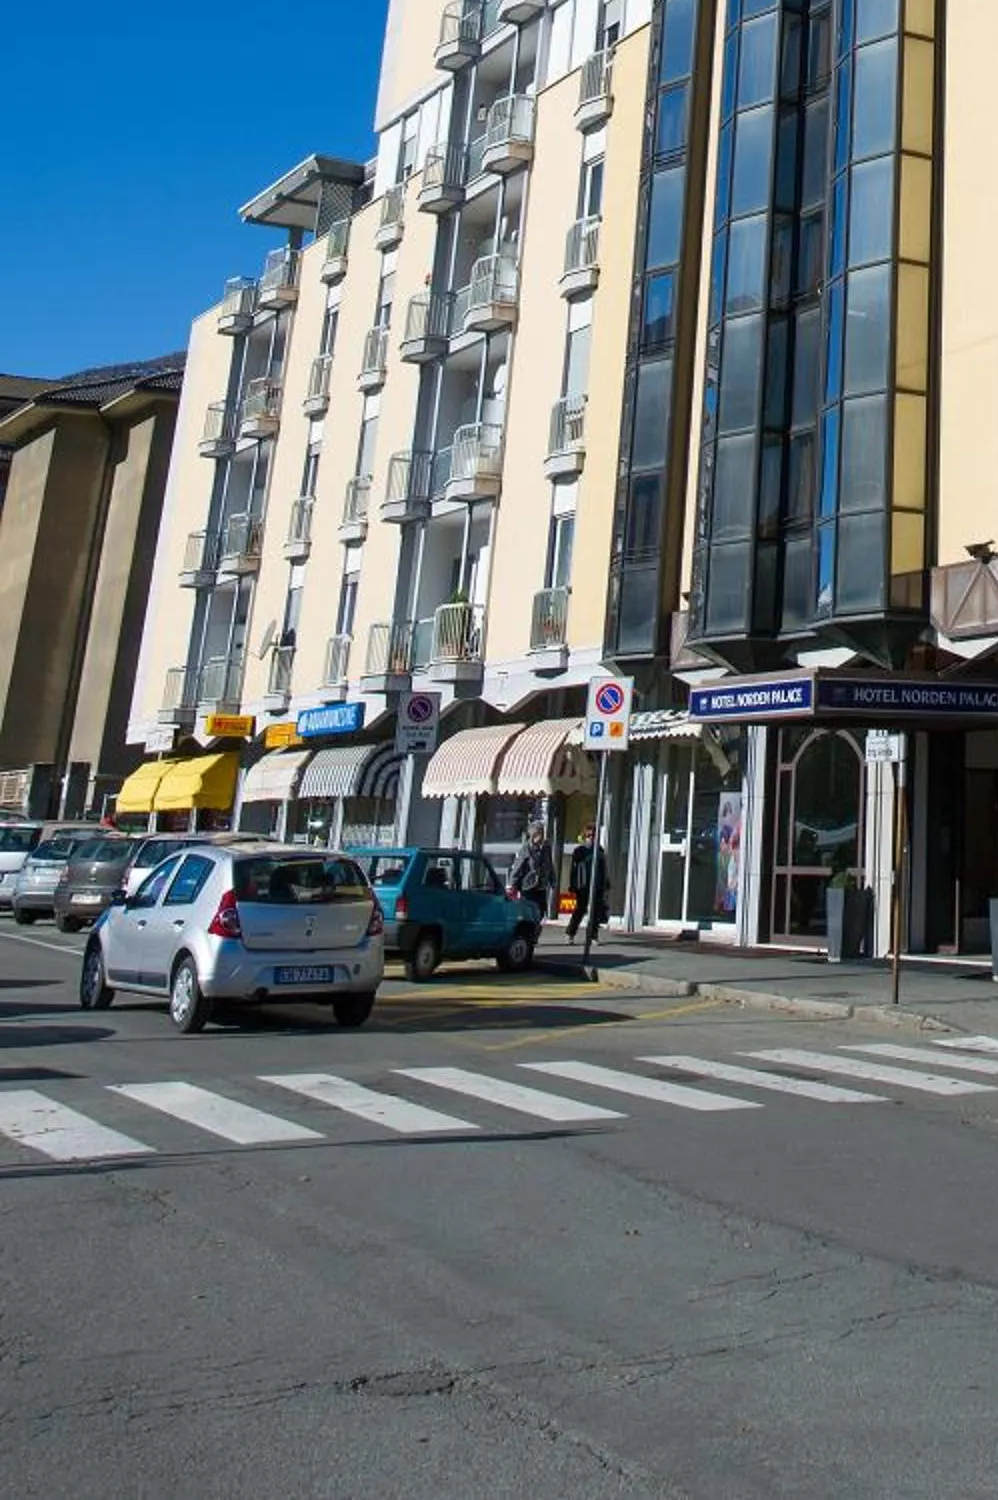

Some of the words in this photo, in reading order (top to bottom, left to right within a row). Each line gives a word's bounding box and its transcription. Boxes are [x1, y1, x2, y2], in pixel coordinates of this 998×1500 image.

[711, 694, 735, 709] HOTEL
[737, 691, 771, 707] NORDEN
[771, 688, 803, 705] PALACE
[854, 687, 900, 703] HOTEL
[901, 689, 957, 706] NORDEN
